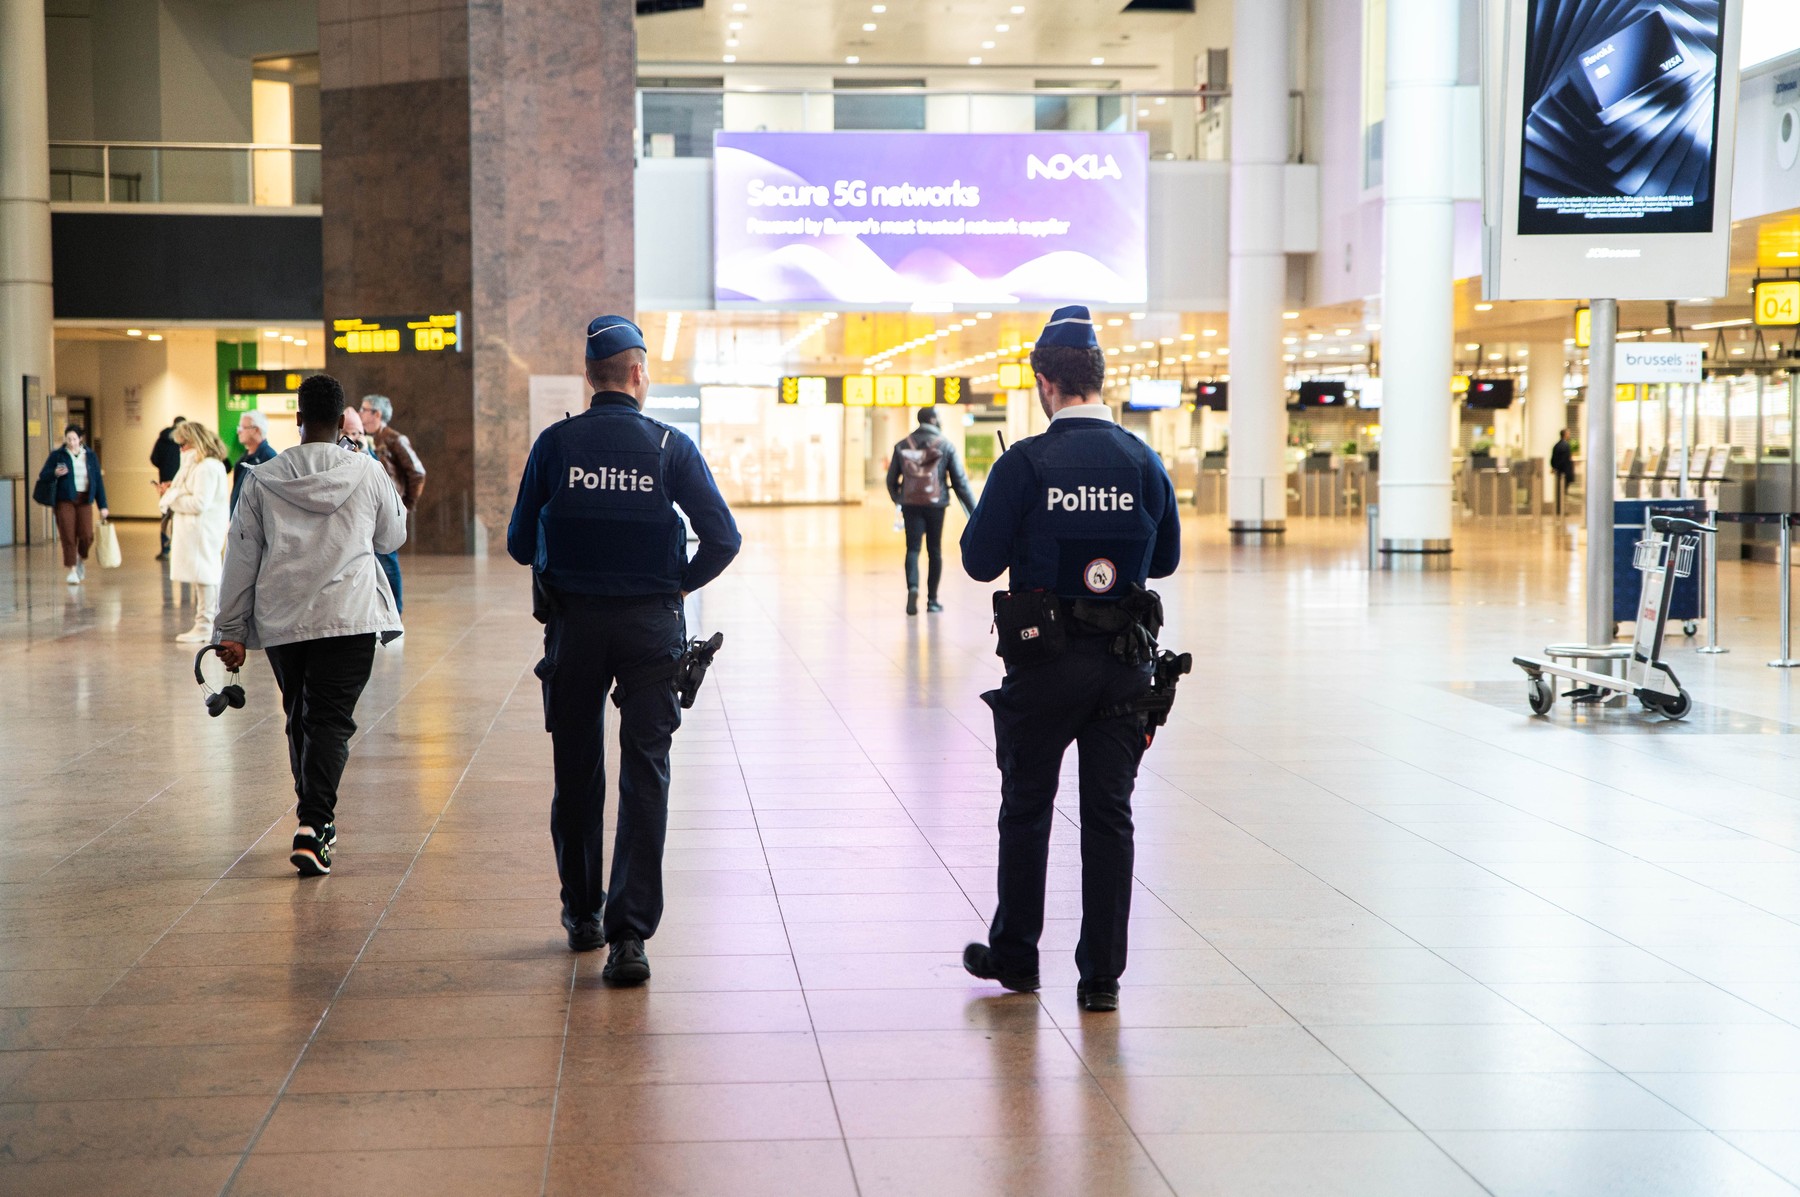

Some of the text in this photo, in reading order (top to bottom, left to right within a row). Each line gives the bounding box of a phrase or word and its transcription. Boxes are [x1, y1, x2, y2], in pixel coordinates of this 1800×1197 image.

[1660, 54, 1683, 71] VISA
[1027, 153, 1122, 180] NOKIA
[746, 179, 980, 207] Secure 5G networks
[1763, 297, 1793, 319] 04
[1626, 353, 1683, 366] brussels
[568, 466, 654, 492] Politie
[1047, 485, 1134, 511] Politie
